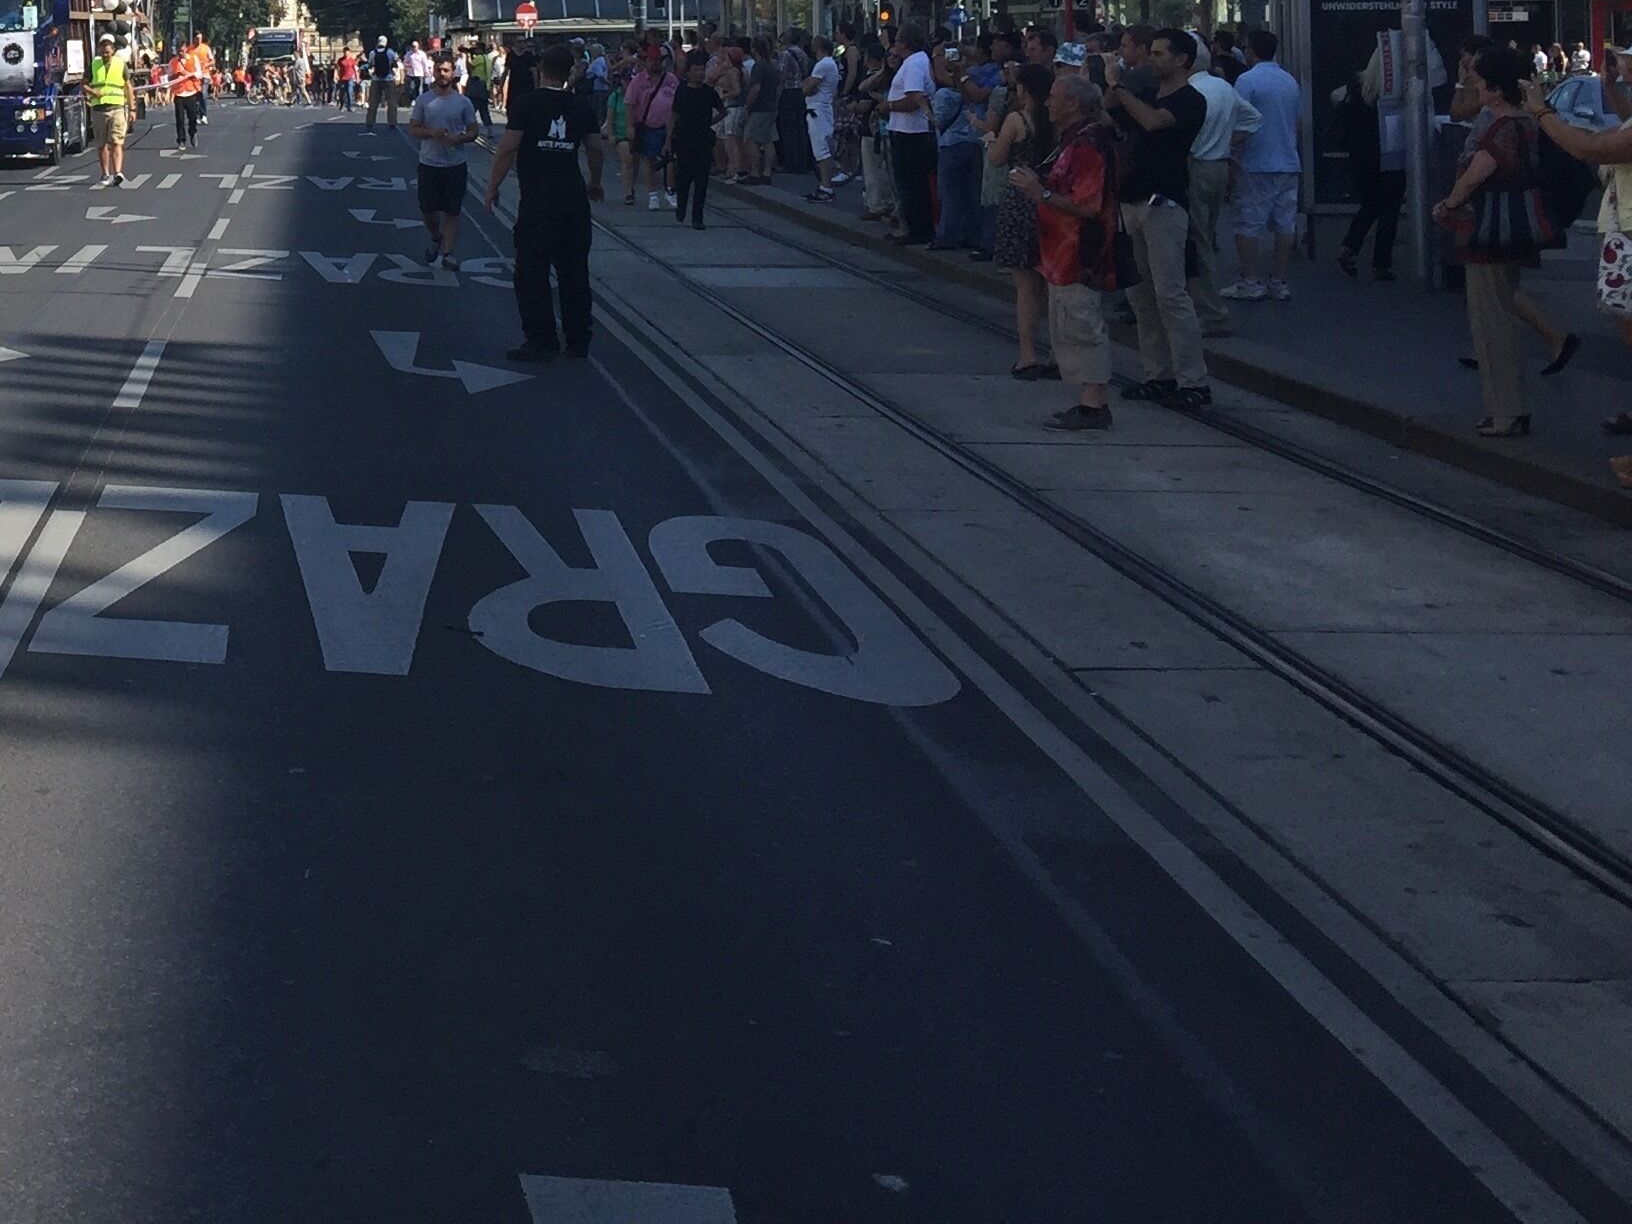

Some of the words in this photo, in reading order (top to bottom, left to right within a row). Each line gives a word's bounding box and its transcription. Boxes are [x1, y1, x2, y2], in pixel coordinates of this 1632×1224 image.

[1430, 0, 1459, 10] STYLE
[245, 173, 418, 191] RAZ
[25, 483, 963, 707] GRAZ
